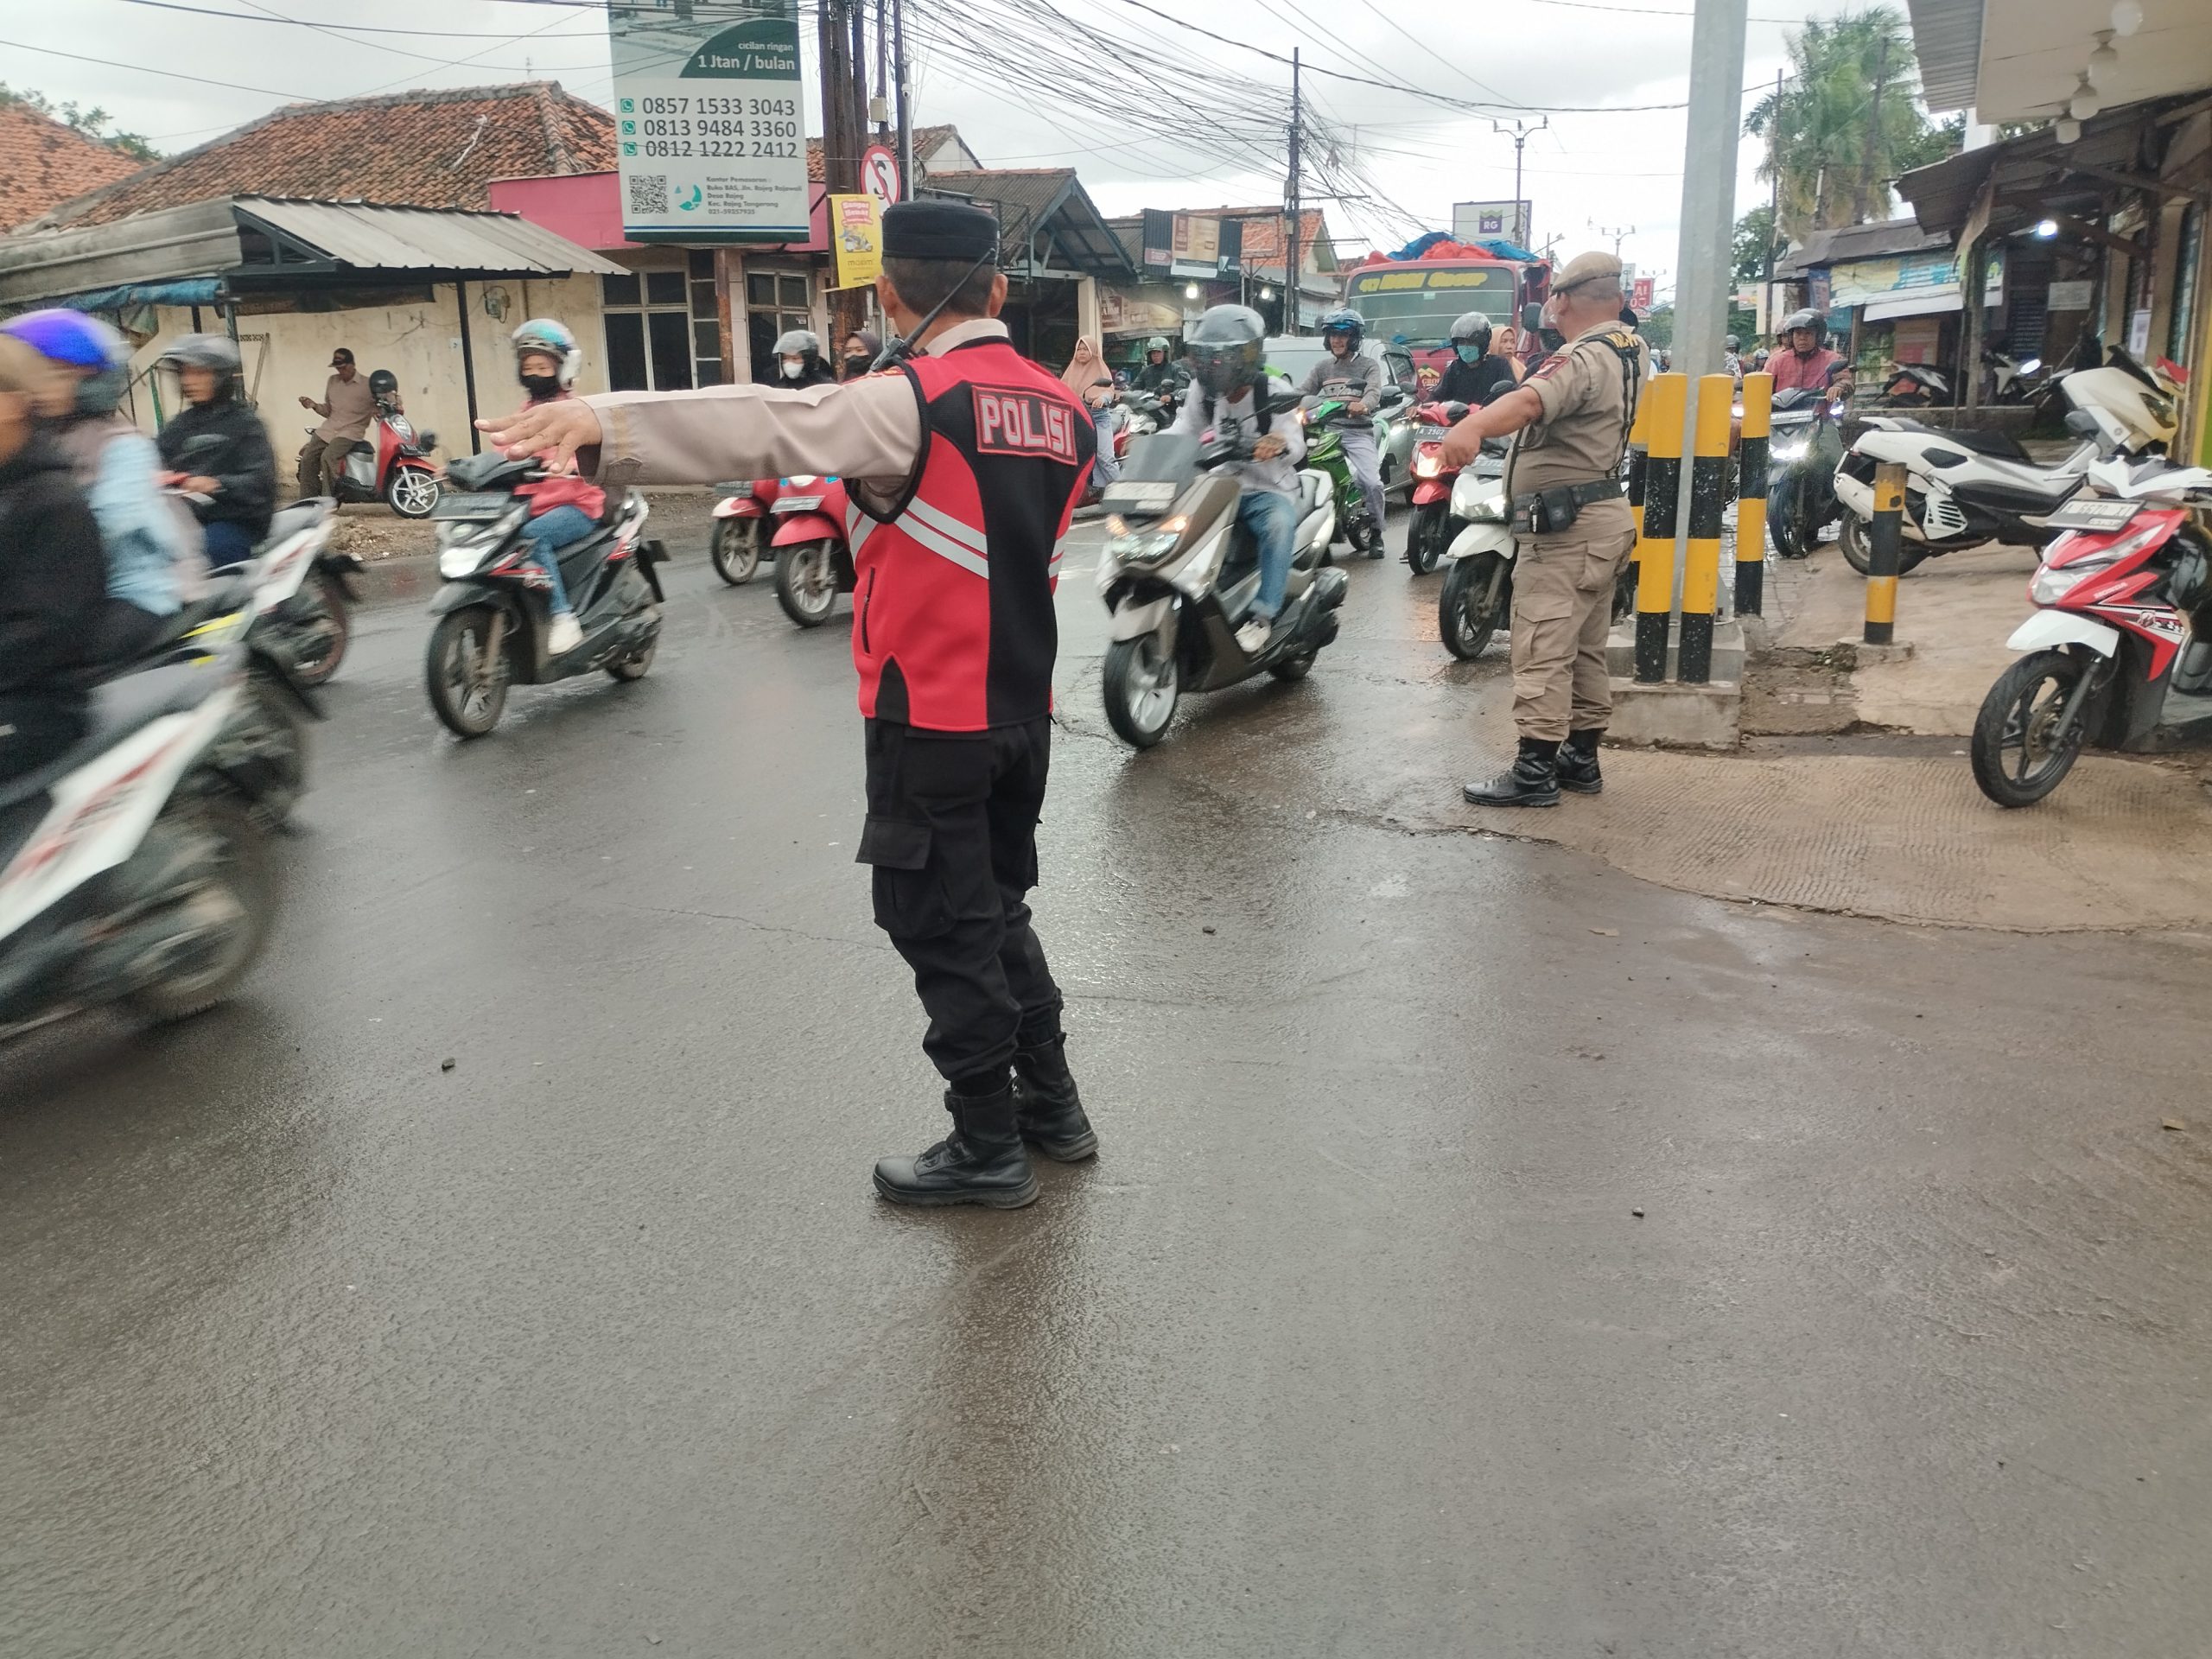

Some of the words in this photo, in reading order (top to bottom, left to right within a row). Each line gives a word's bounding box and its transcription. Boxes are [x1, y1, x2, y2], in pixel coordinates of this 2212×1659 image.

[738, 41, 765, 50] cicilan
[767, 42, 793, 52] ringan
[698, 55, 707, 67] 1
[710, 55, 740, 68] Jtan
[755, 56, 795, 70] bulan
[643, 98, 689, 114] 0857
[696, 98, 743, 115] 1533
[749, 99, 795, 116] 3043
[644, 120, 690, 137] 0813
[697, 120, 744, 137] 9484
[750, 121, 797, 137] 3360
[645, 140, 692, 156] 0812
[700, 141, 745, 157] 1222
[752, 142, 798, 157] 2412
[1483, 220, 1498, 230] RG
[979, 394, 1073, 457] POLISI
